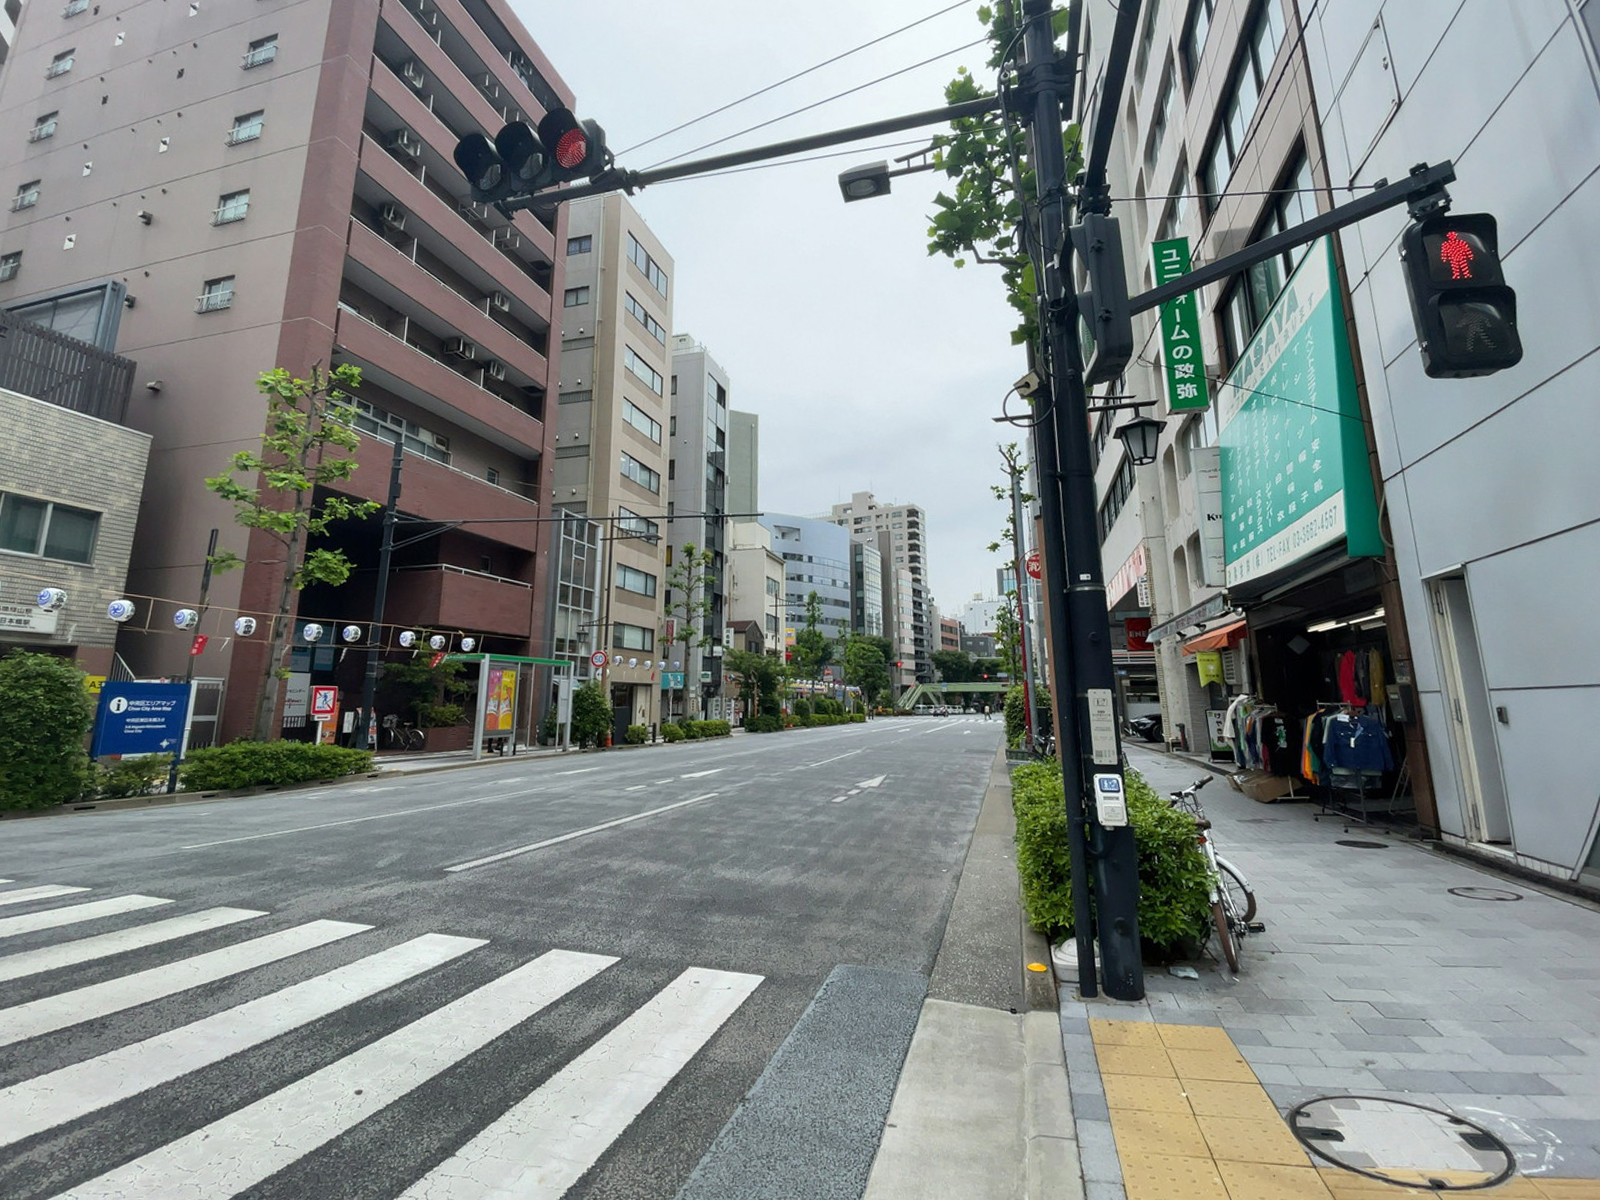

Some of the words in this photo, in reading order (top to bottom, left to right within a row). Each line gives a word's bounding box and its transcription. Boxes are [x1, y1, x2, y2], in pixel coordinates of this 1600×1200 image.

[1161, 248, 1199, 400] ユニォームの政弥
